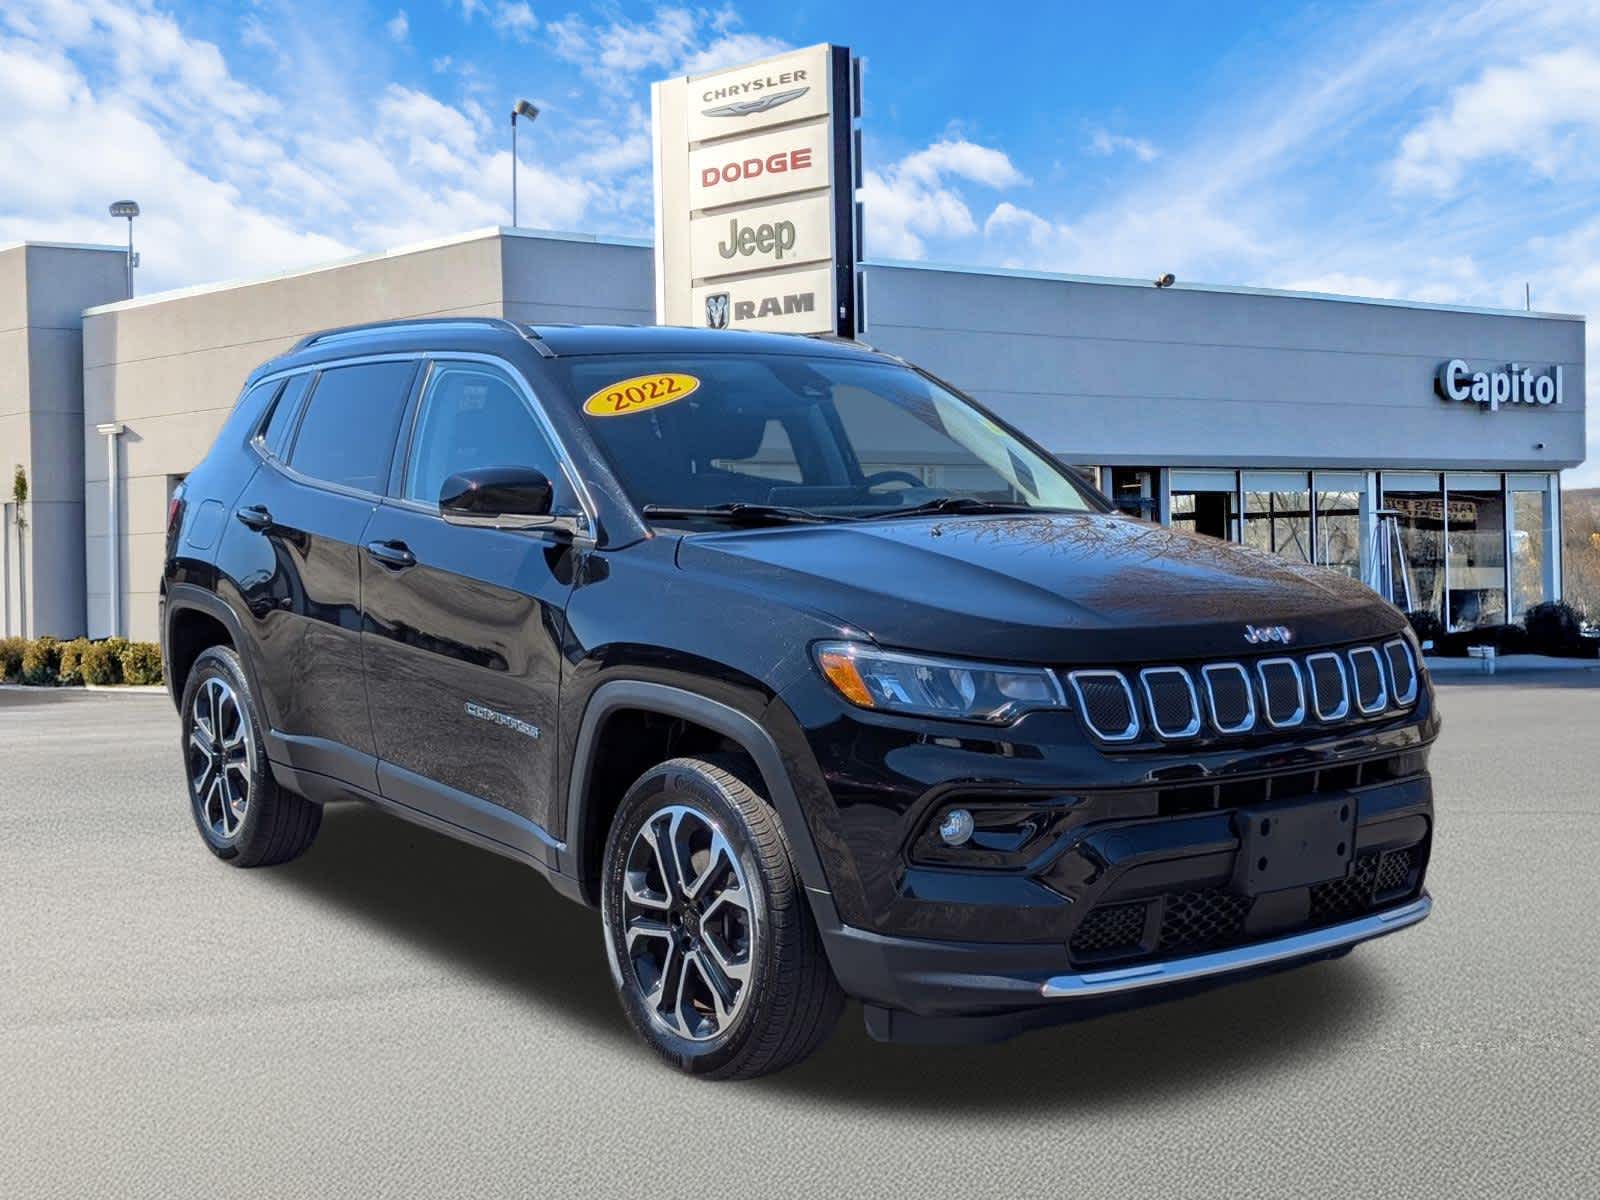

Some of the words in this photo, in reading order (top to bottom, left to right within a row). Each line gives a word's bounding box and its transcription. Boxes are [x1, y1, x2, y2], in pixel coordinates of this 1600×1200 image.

[702, 69, 808, 103] CHRYSLER
[702, 148, 812, 188] DODGE
[718, 218, 796, 260] Jeep
[734, 292, 815, 321] RAM
[606, 377, 682, 411] 2022
[1446, 359, 1563, 411] Capitol
[1244, 624, 1292, 644] Jeep
